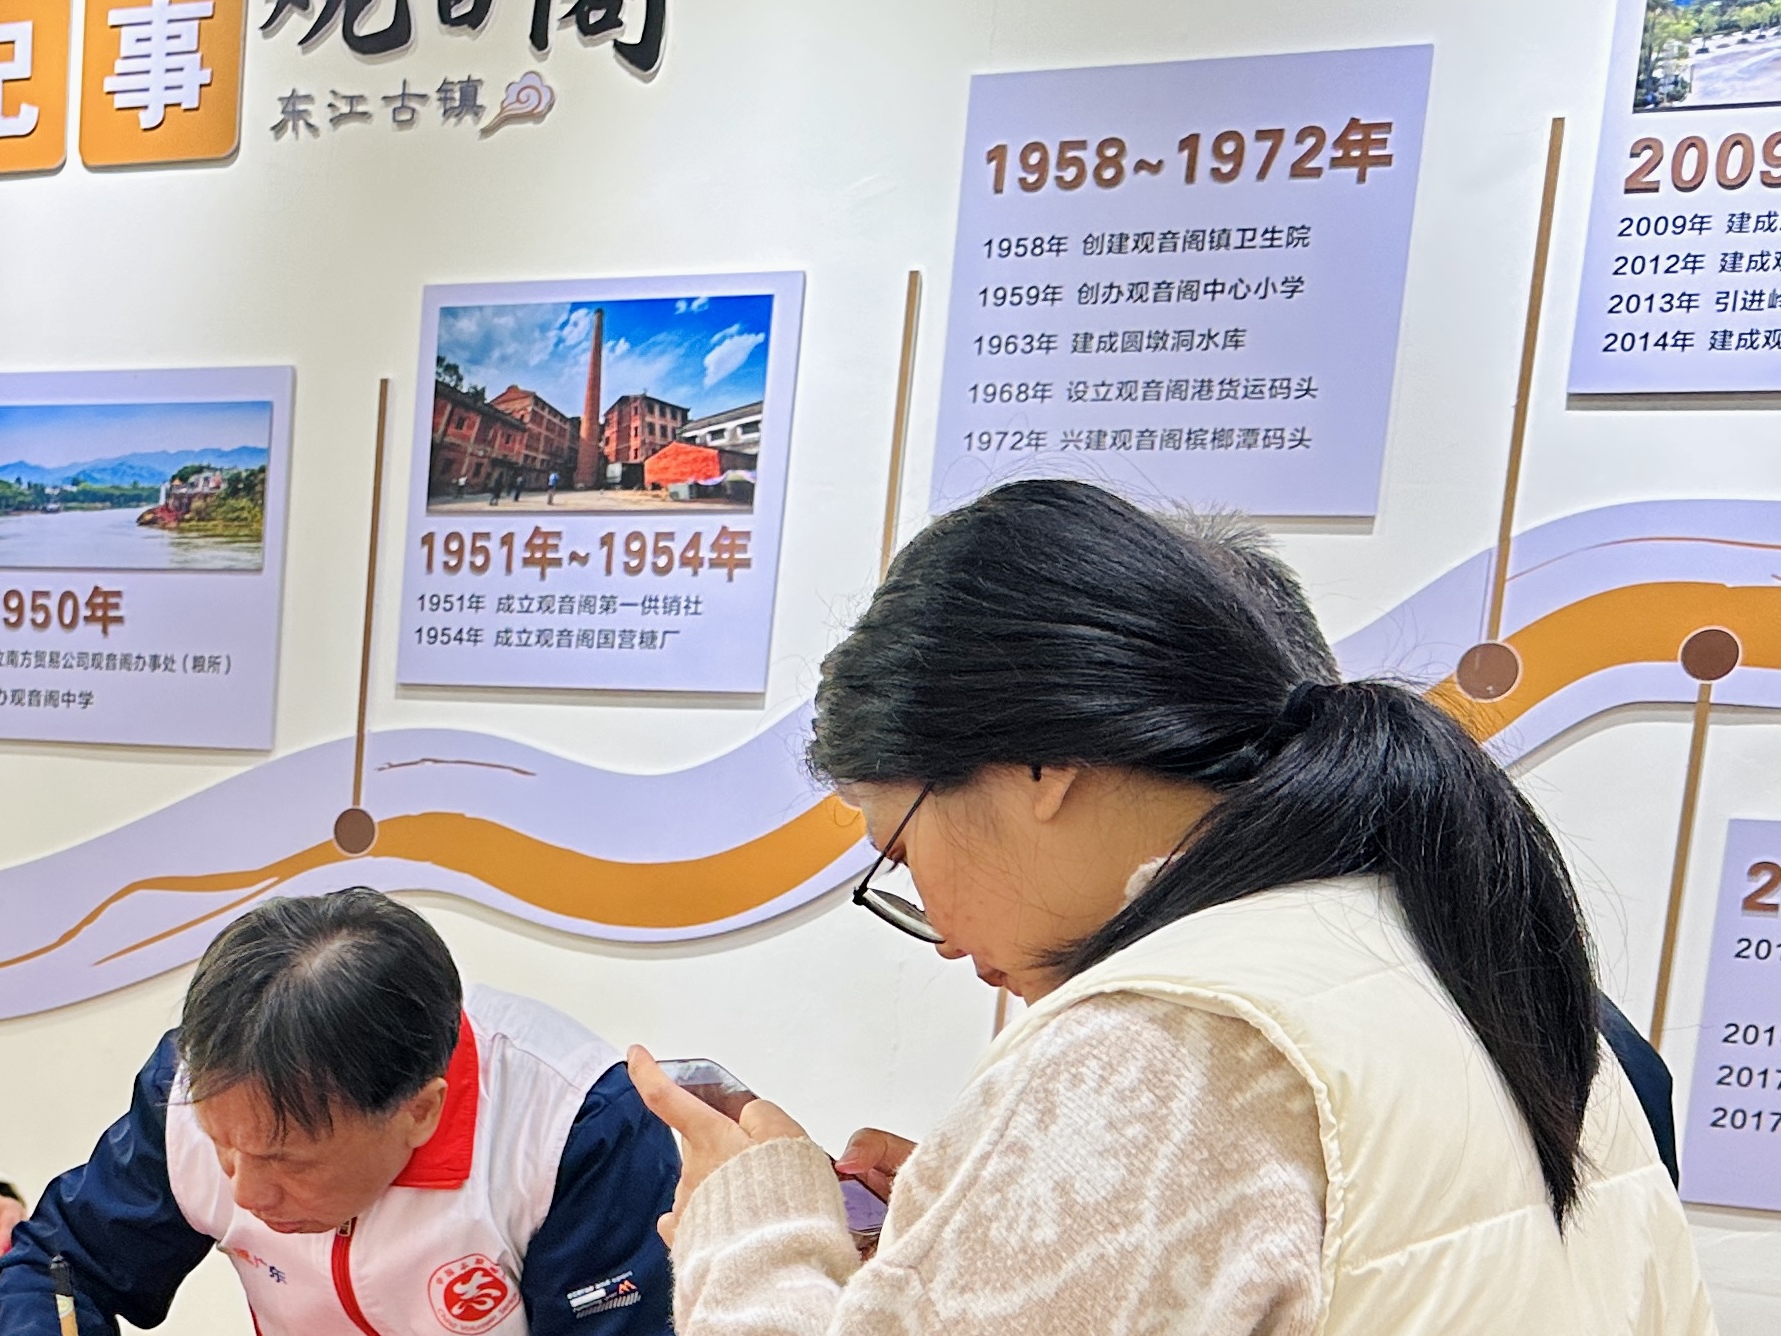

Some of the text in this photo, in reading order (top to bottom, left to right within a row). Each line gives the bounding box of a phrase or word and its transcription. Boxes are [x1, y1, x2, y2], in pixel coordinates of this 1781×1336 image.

[271, 75, 485, 140] 东江古镇
[985, 117, 1394, 195] 1958~1972年
[1617, 211, 1781, 236] 2009年 建成
[982, 225, 1312, 259] 1958年 创建观音阁镇卫生院
[1612, 252, 1705, 276] 2012年
[978, 276, 1305, 308] 1959年 创办观音阁中心小学
[1607, 291, 1700, 314] 2013年
[972, 328, 1246, 357] 1963年 建成圆墩洞水库
[1603, 331, 1695, 353] 2014年
[967, 377, 1319, 405] 1968年 设立观音阁港货运码头
[962, 428, 1313, 452] 1972年 兴建观音阁槟榔潭码头
[421, 525, 752, 582] 1951年~1954年
[417, 594, 703, 616] 1951年 成立观音阁第一供销社
[415, 627, 680, 650] 1954年 成立观音阁国营糖厂
[1722, 1023, 1781, 1047] 201
